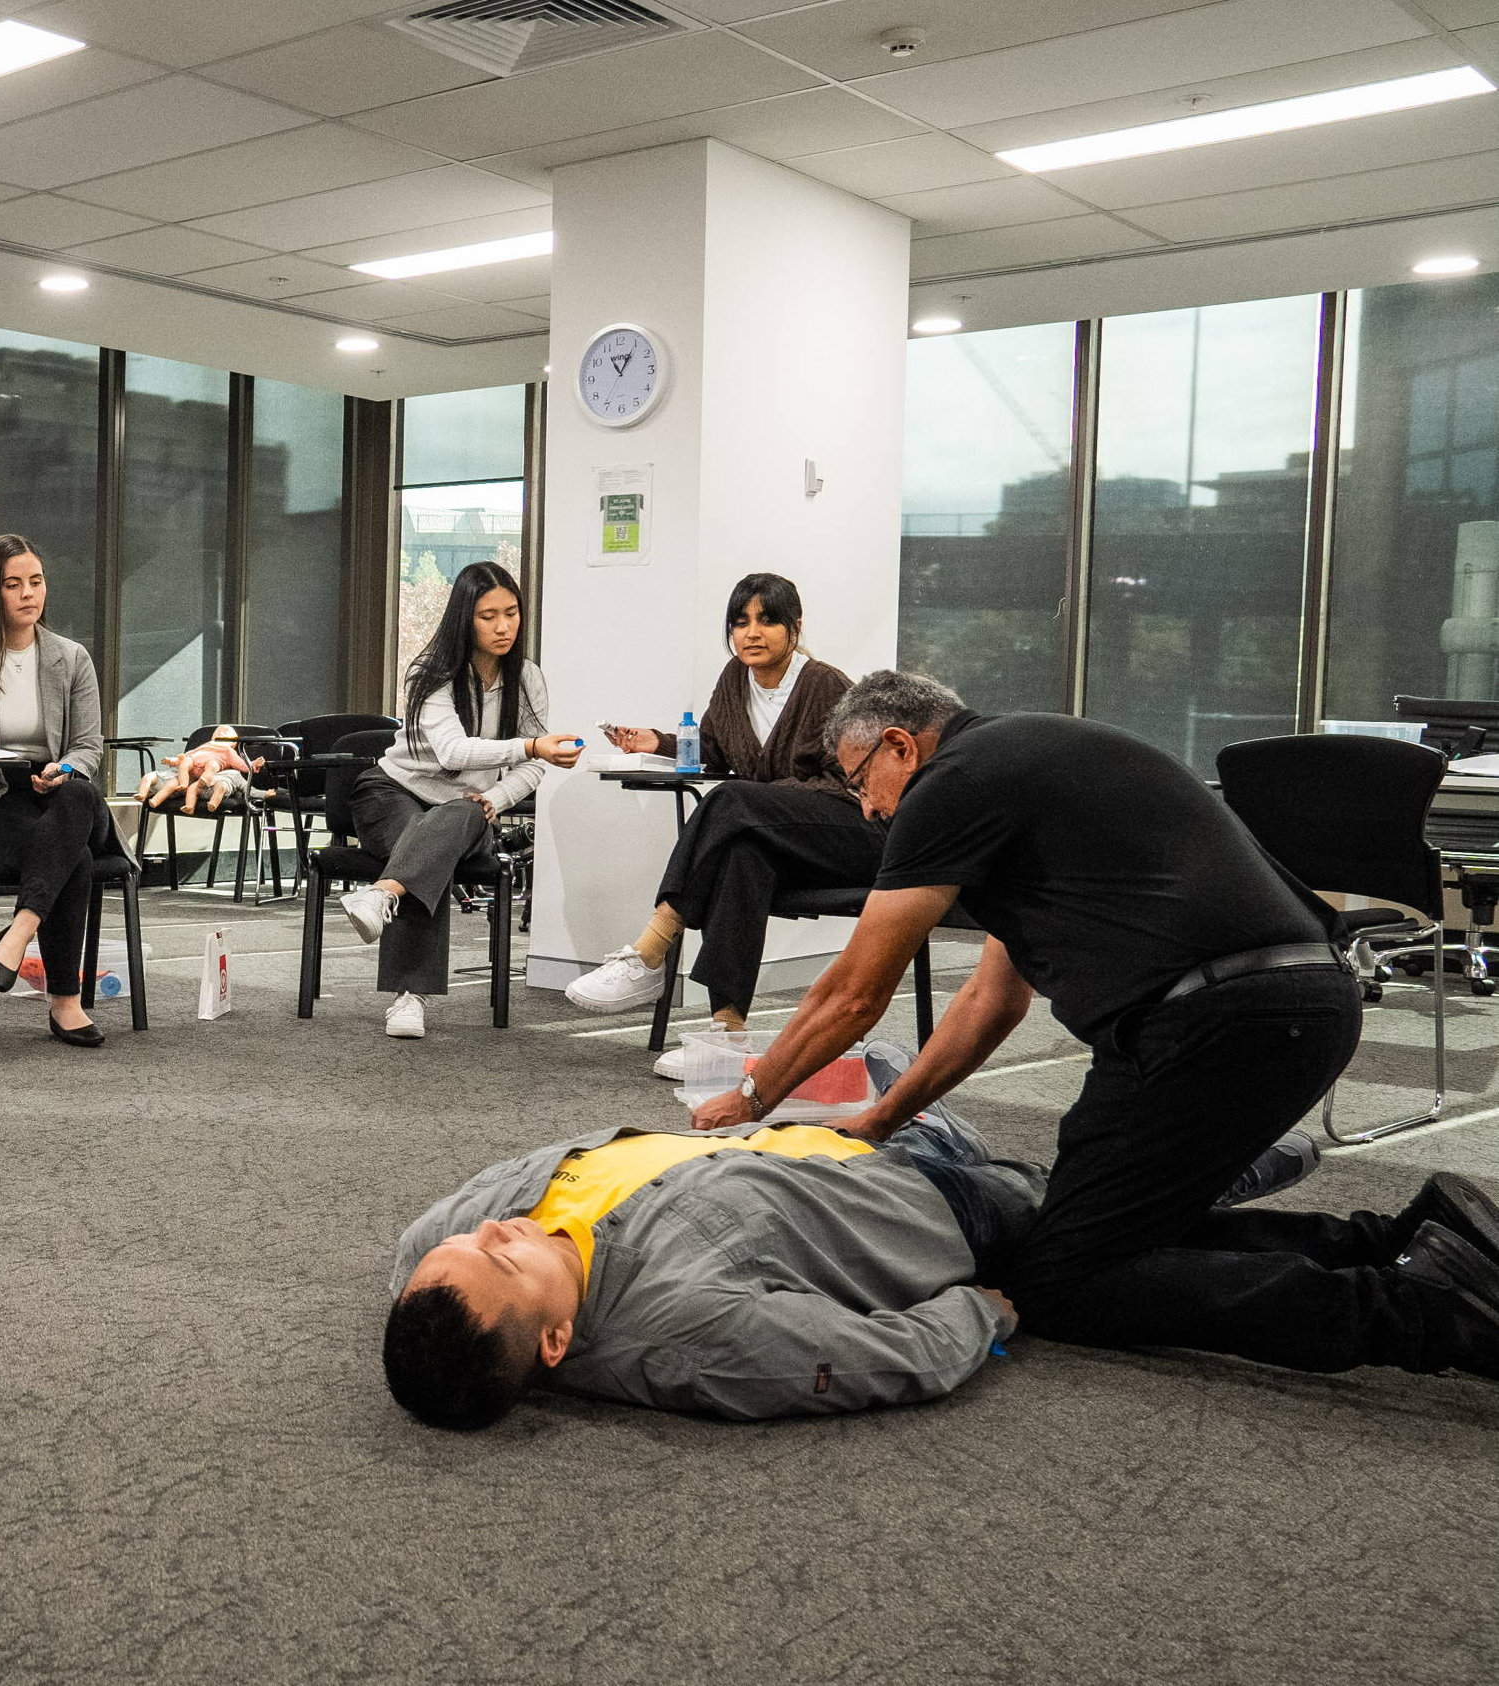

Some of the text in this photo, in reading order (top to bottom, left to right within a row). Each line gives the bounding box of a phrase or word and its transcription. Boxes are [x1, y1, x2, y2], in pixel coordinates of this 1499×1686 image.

[616, 336, 625, 346] 12
[603, 343, 611, 353] 11
[644, 349, 651, 358] 2
[592, 358, 602, 368] 10
[648, 365, 655, 375] 3
[588, 375, 595, 384] 9
[593, 392, 599, 400] 8
[604, 402, 610, 411] 7
[633, 397, 640, 407] 5
[618, 404, 626, 413] 6
